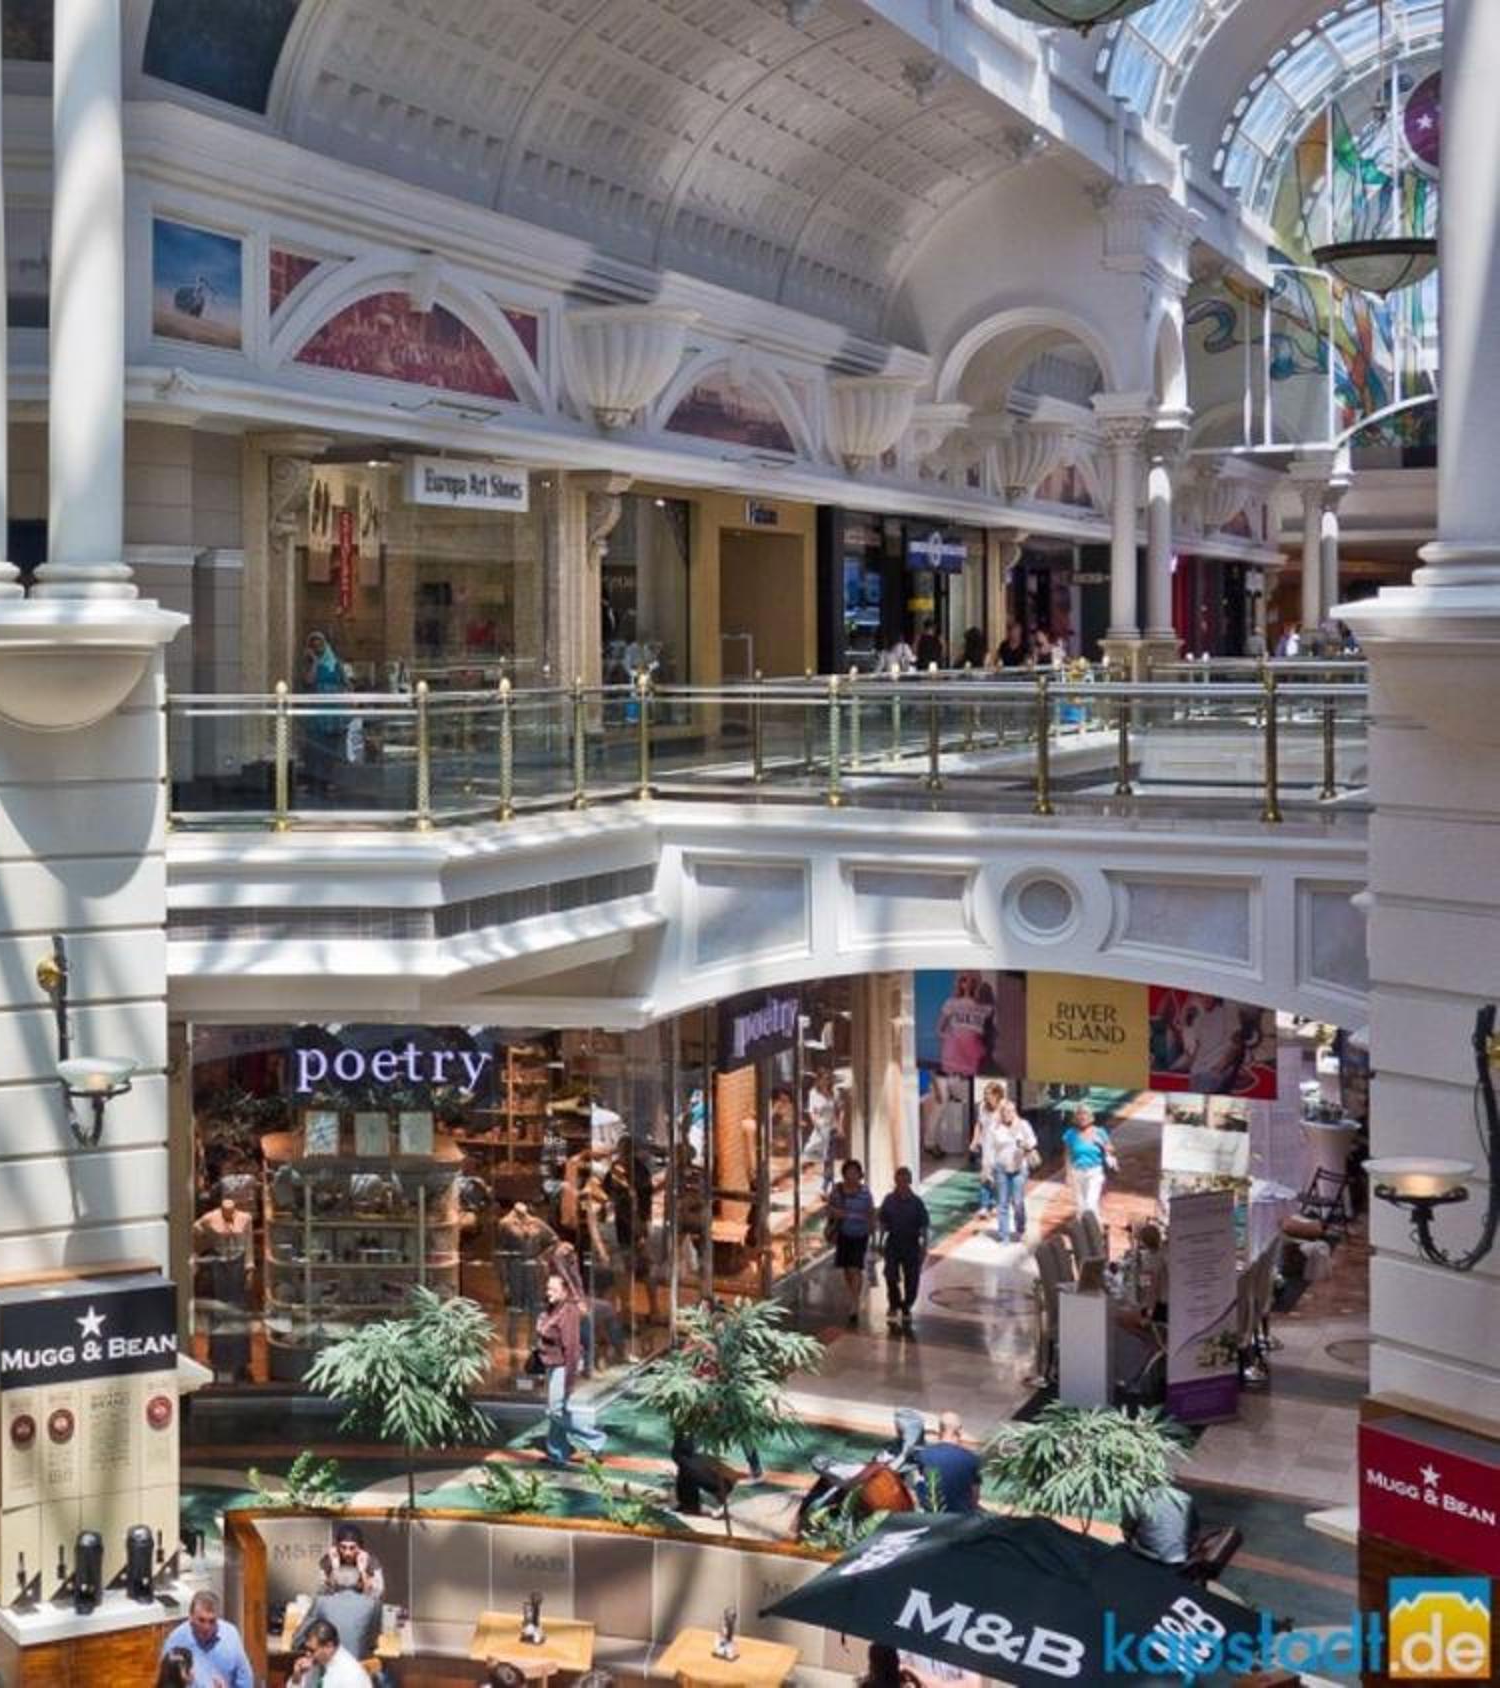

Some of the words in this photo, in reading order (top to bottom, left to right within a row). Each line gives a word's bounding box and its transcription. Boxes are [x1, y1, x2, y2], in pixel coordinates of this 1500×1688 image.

[423, 467, 466, 500] Europa
[469, 473, 488, 497] Art
[733, 994, 799, 1058] poetry
[1047, 1021, 1126, 1044] ISLAND
[1056, 1001, 1116, 1024] RIVER
[295, 1042, 492, 1096] poetry
[1, 1347, 75, 1371] MUGG
[82, 1341, 102, 1362] &
[108, 1334, 177, 1359] BEAN
[1366, 1469, 1420, 1500] MUGG
[1423, 1489, 1439, 1507] &
[1443, 1493, 1496, 1527] BEAN
[894, 1588, 1085, 1679] M&B
